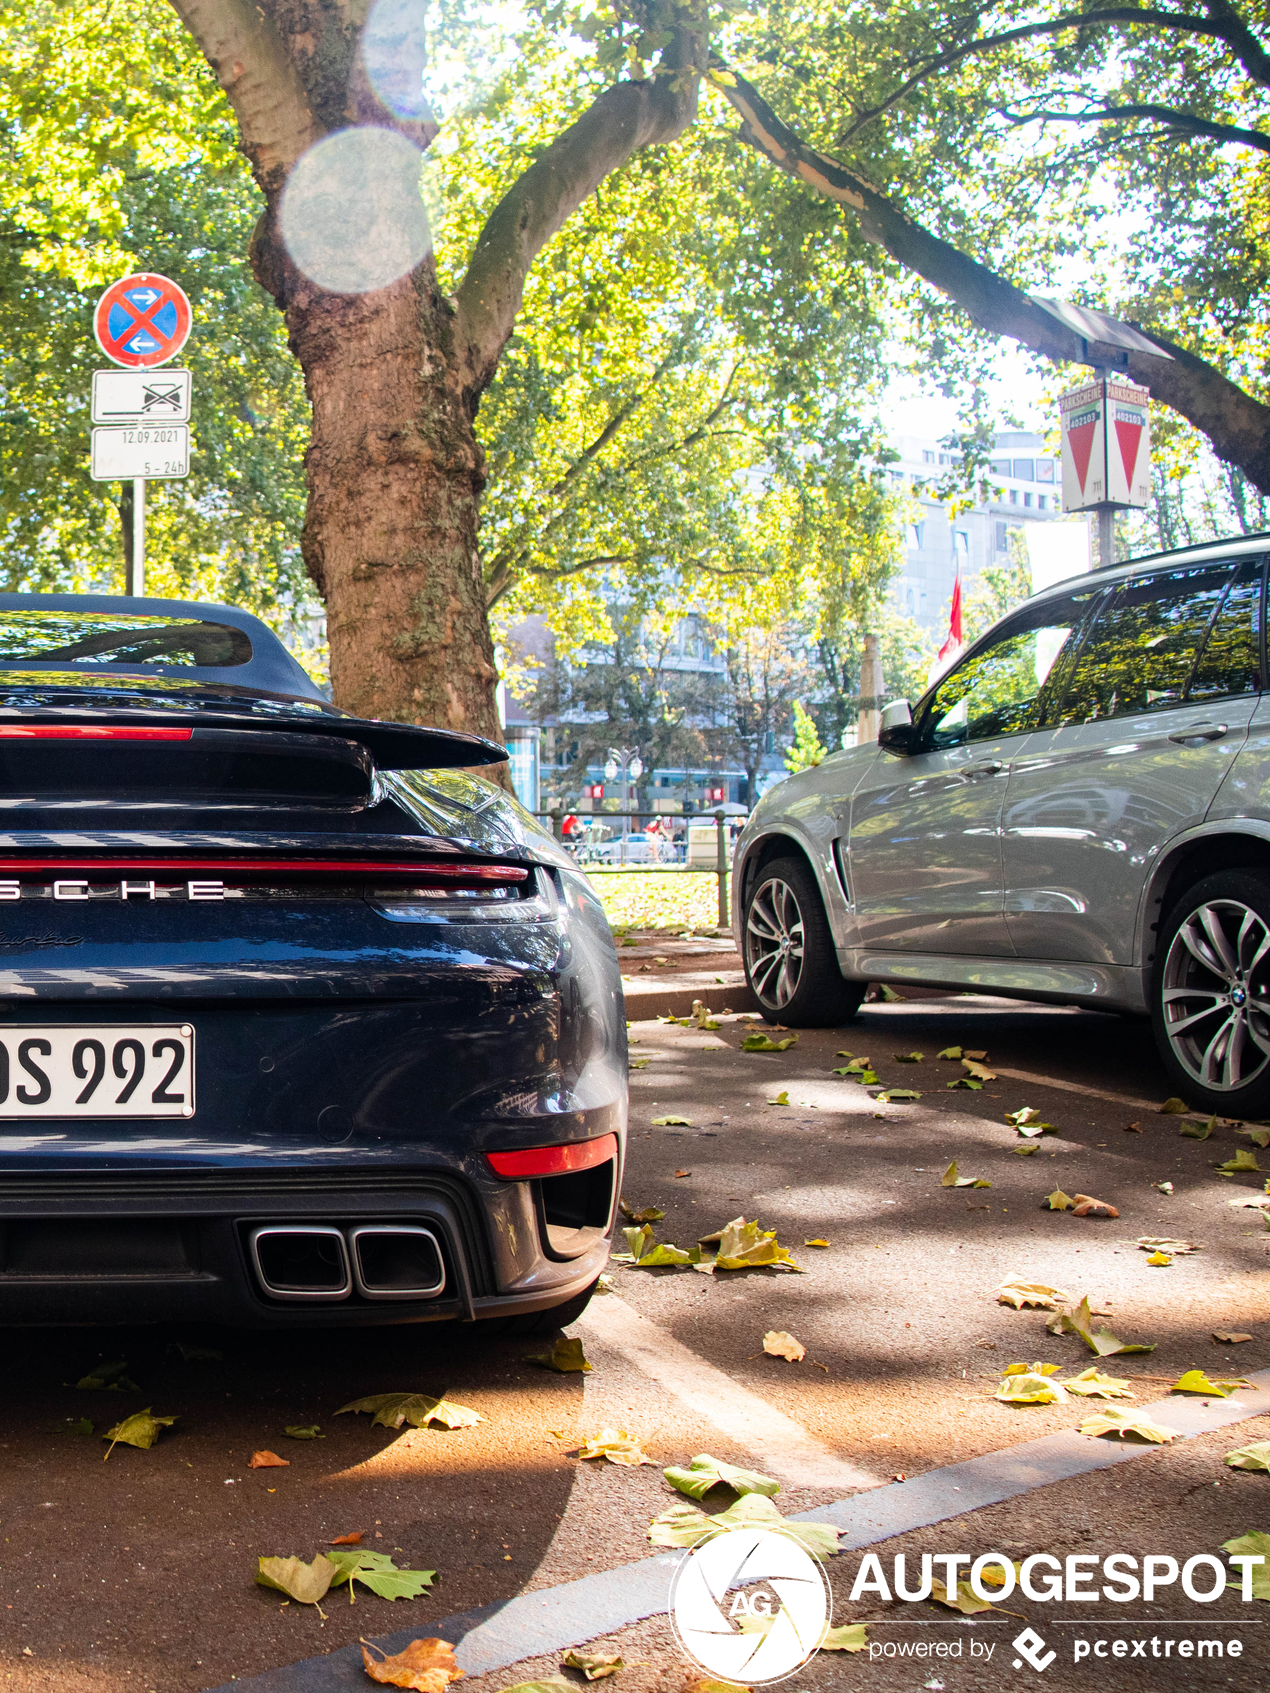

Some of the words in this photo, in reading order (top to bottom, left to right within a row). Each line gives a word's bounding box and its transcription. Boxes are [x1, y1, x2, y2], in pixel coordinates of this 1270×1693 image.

[1062, 385, 1102, 411] PARKSCHEINE
[1107, 384, 1148, 407] PARKSCHEINE
[1070, 412, 1096, 429] 402103
[1116, 412, 1142, 425] 402103
[122, 430, 178, 444] 12.09.2021
[144, 462, 151, 475] 5
[164, 461, 184, 474] 24h
[1093, 481, 1102, 493] 711
[1139, 485, 1147, 497] 711
[72, 1037, 186, 1104] 992
